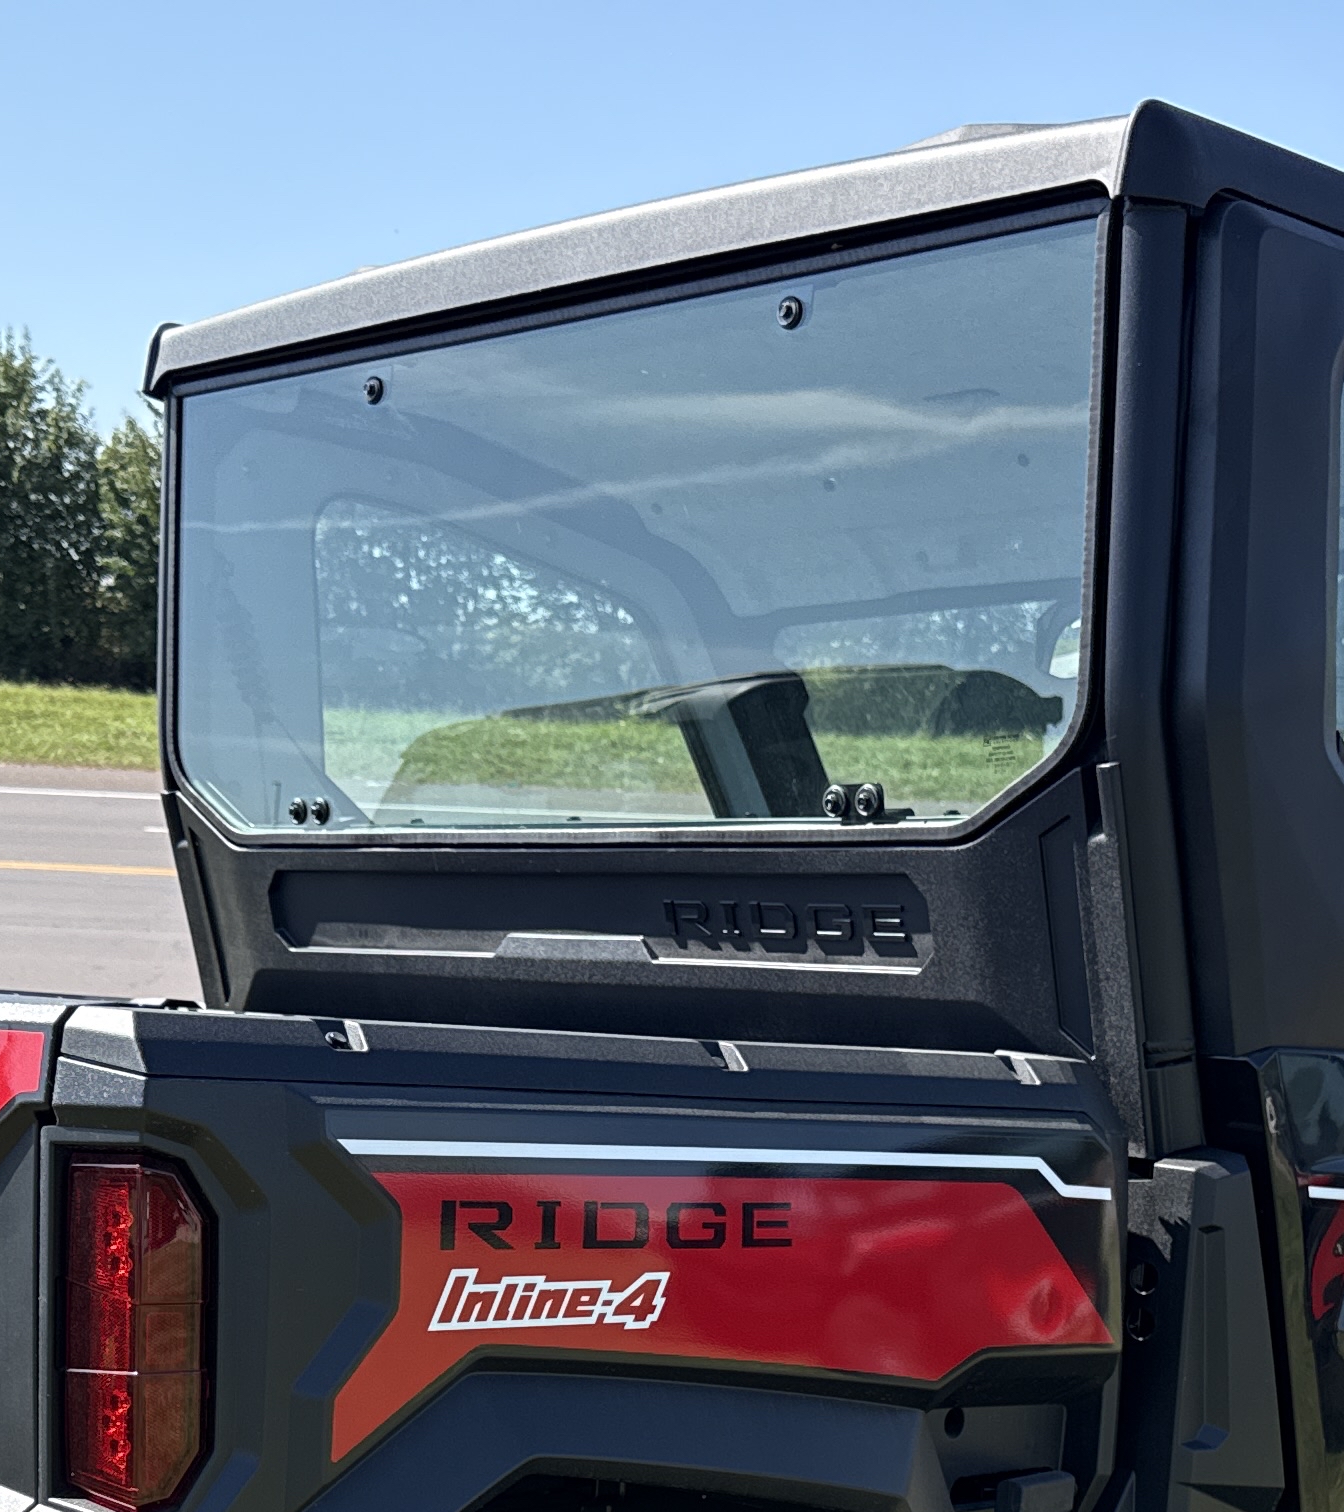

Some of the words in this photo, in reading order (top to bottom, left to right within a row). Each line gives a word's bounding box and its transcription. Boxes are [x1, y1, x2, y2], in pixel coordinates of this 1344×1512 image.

[663, 900, 907, 942] RIDGE
[440, 1199, 793, 1251] RIDGE
[428, 1268, 670, 1332] Inline-4
